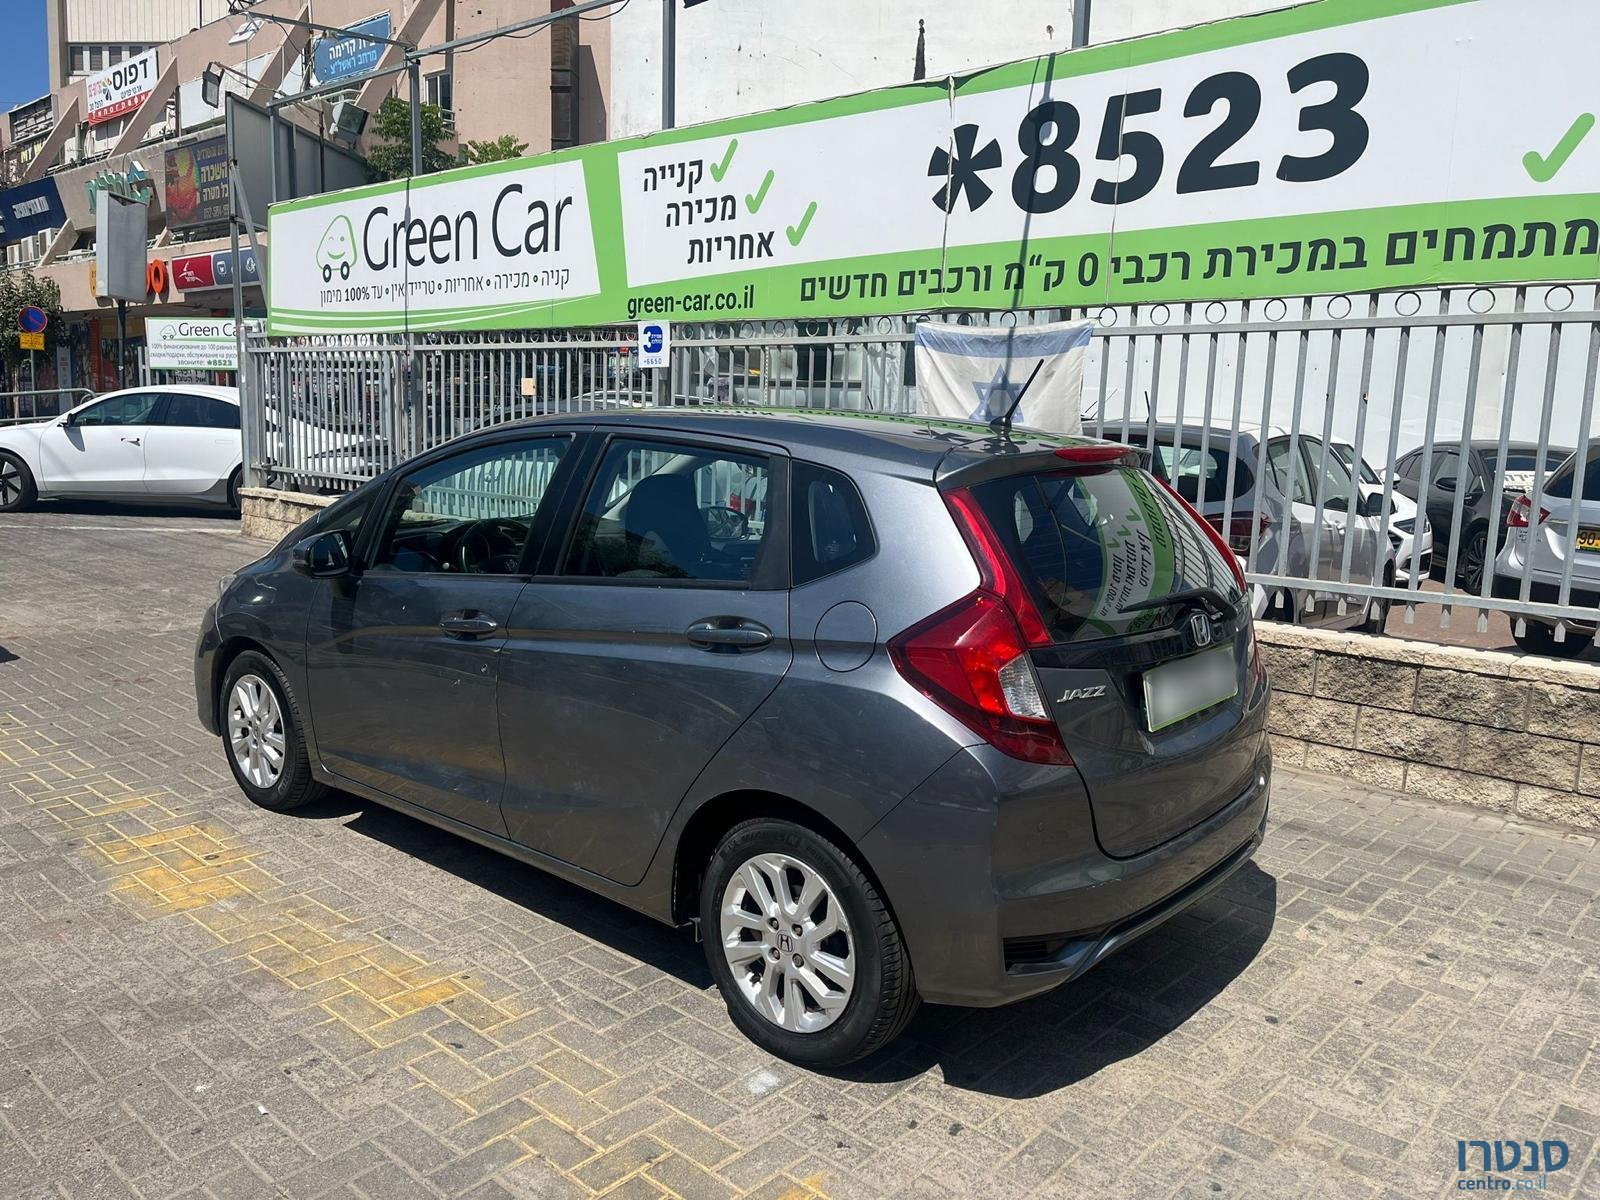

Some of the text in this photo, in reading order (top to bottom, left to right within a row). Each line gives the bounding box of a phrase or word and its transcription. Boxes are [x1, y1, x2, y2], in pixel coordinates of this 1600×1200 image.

[112, 58, 148, 91] דפוס
[643, 159, 703, 194] קנייה
[363, 183, 573, 271] Green Car
[665, 194, 737, 228] מכירה
[687, 230, 775, 264] אחריות
[1203, 236, 1367, 279] במכירת
[1386, 218, 1600, 266] מתמחים
[897, 264, 992, 296] ורכבים
[1078, 252, 1099, 287] 0
[1111, 251, 1190, 285] רכבי
[320, 267, 570, 308] קניה מכירה אחריות טרייד אין עד 100% מימון
[627, 285, 754, 319] green-car.co.il
[800, 272, 888, 302] חדשים
[178, 322, 237, 337] Green Ca
[1056, 685, 1107, 703] JAZZ
